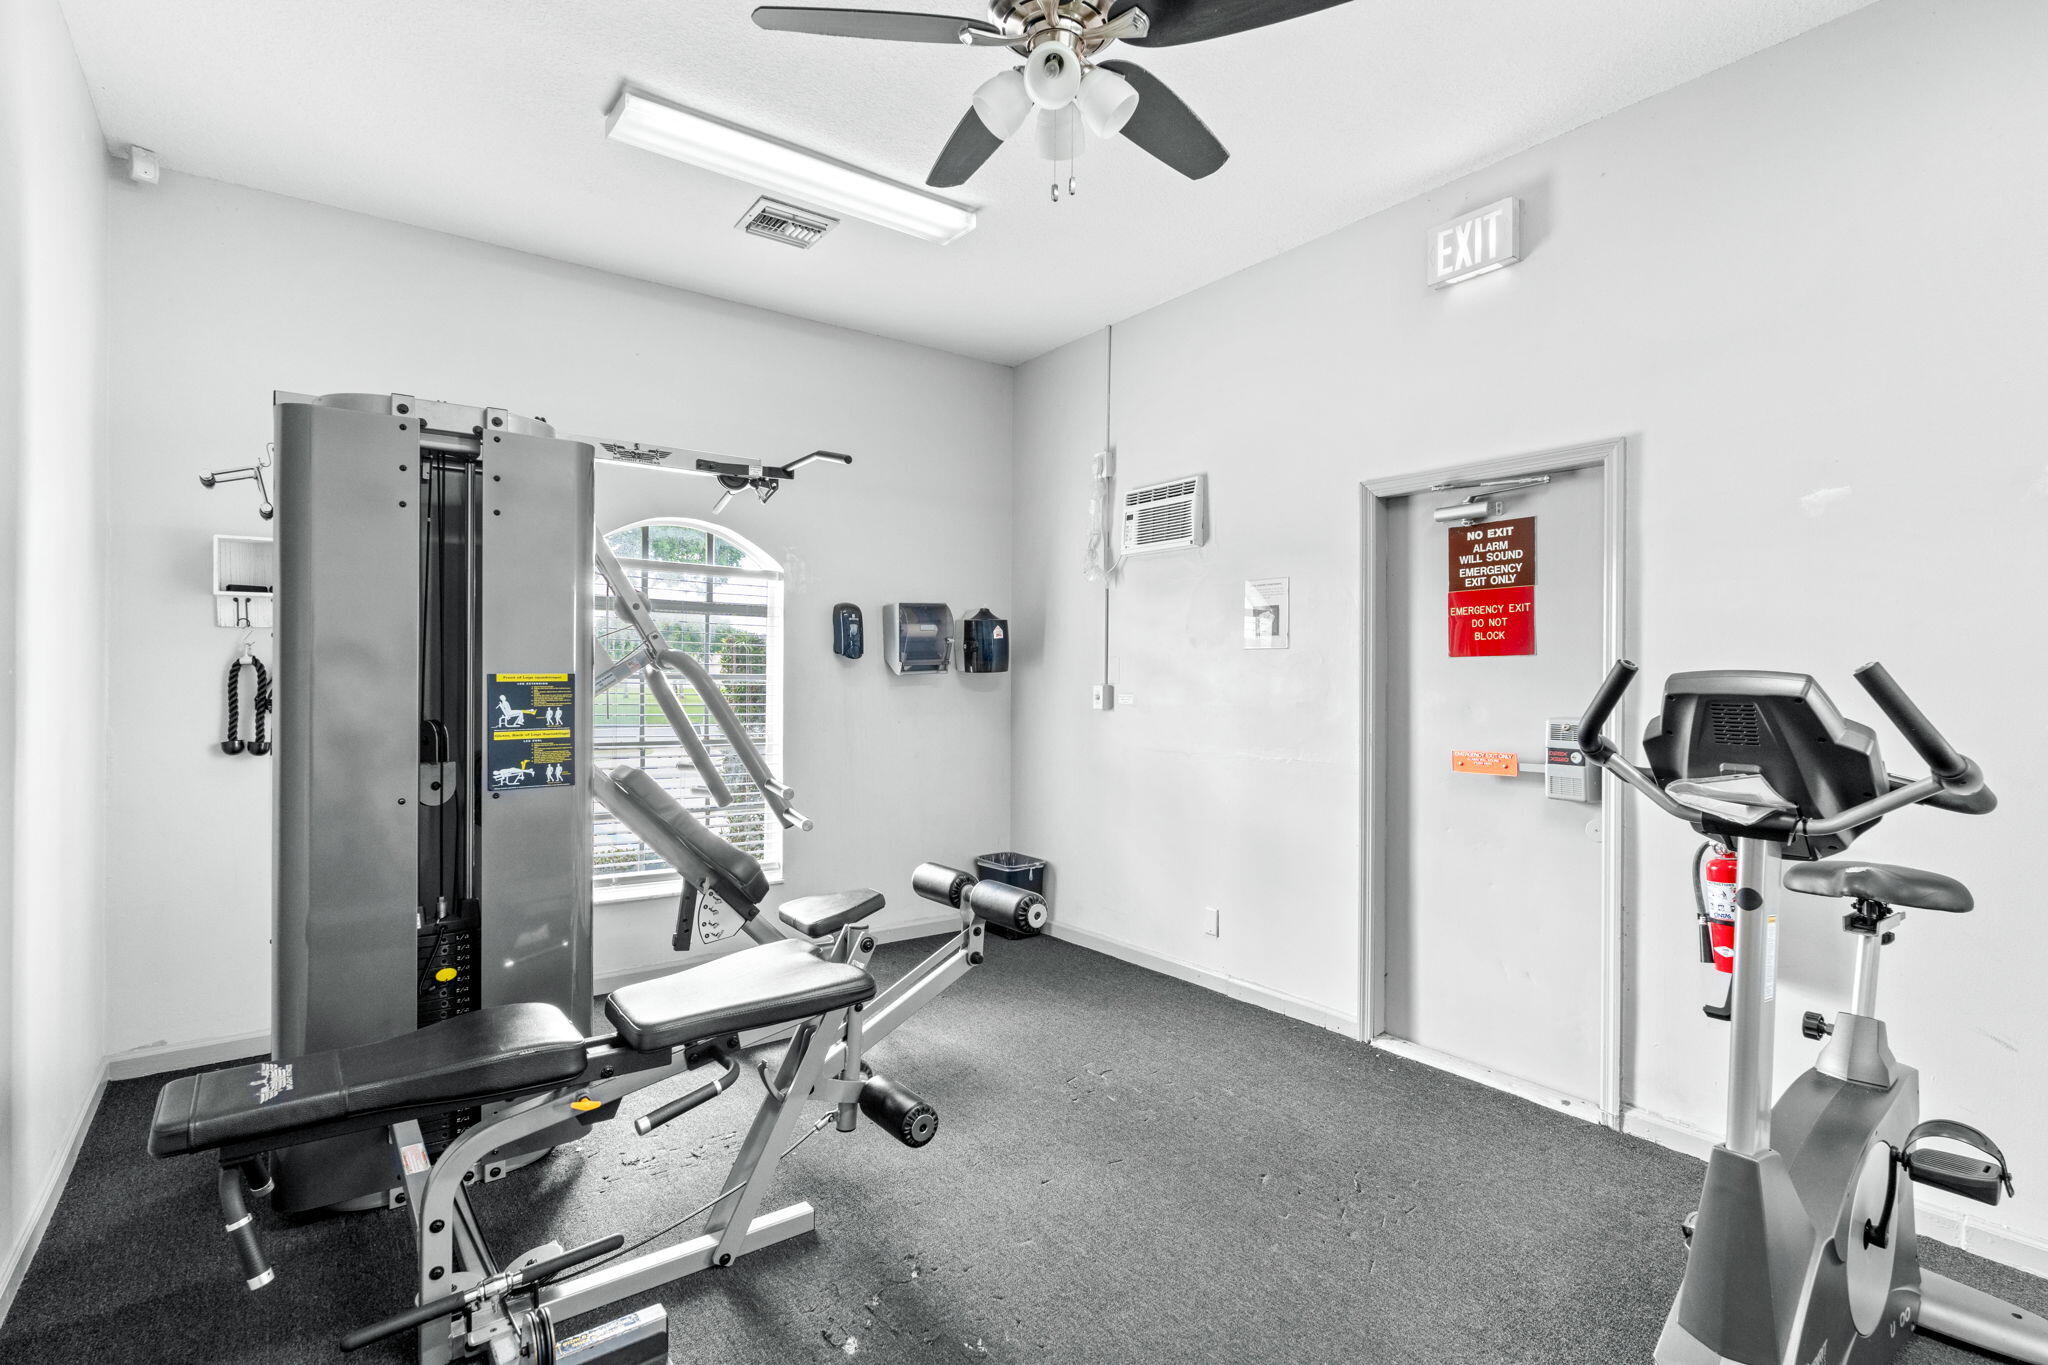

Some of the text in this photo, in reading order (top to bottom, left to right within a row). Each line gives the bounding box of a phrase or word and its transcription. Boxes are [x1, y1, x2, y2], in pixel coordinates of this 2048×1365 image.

[1437, 209, 1503, 277] EXIT
[1467, 526, 1514, 541] NO EXIT
[1473, 540, 1508, 553] ALARM
[1459, 550, 1523, 564] WILL SOUND
[1459, 563, 1522, 577] EMERGENCY
[1465, 574, 1516, 587] EXIT ONLY
[1450, 602, 1531, 616] EMERGENCY EXIT
[1471, 617, 1508, 628] DO NOT
[1474, 631, 1505, 641] BLOCK
